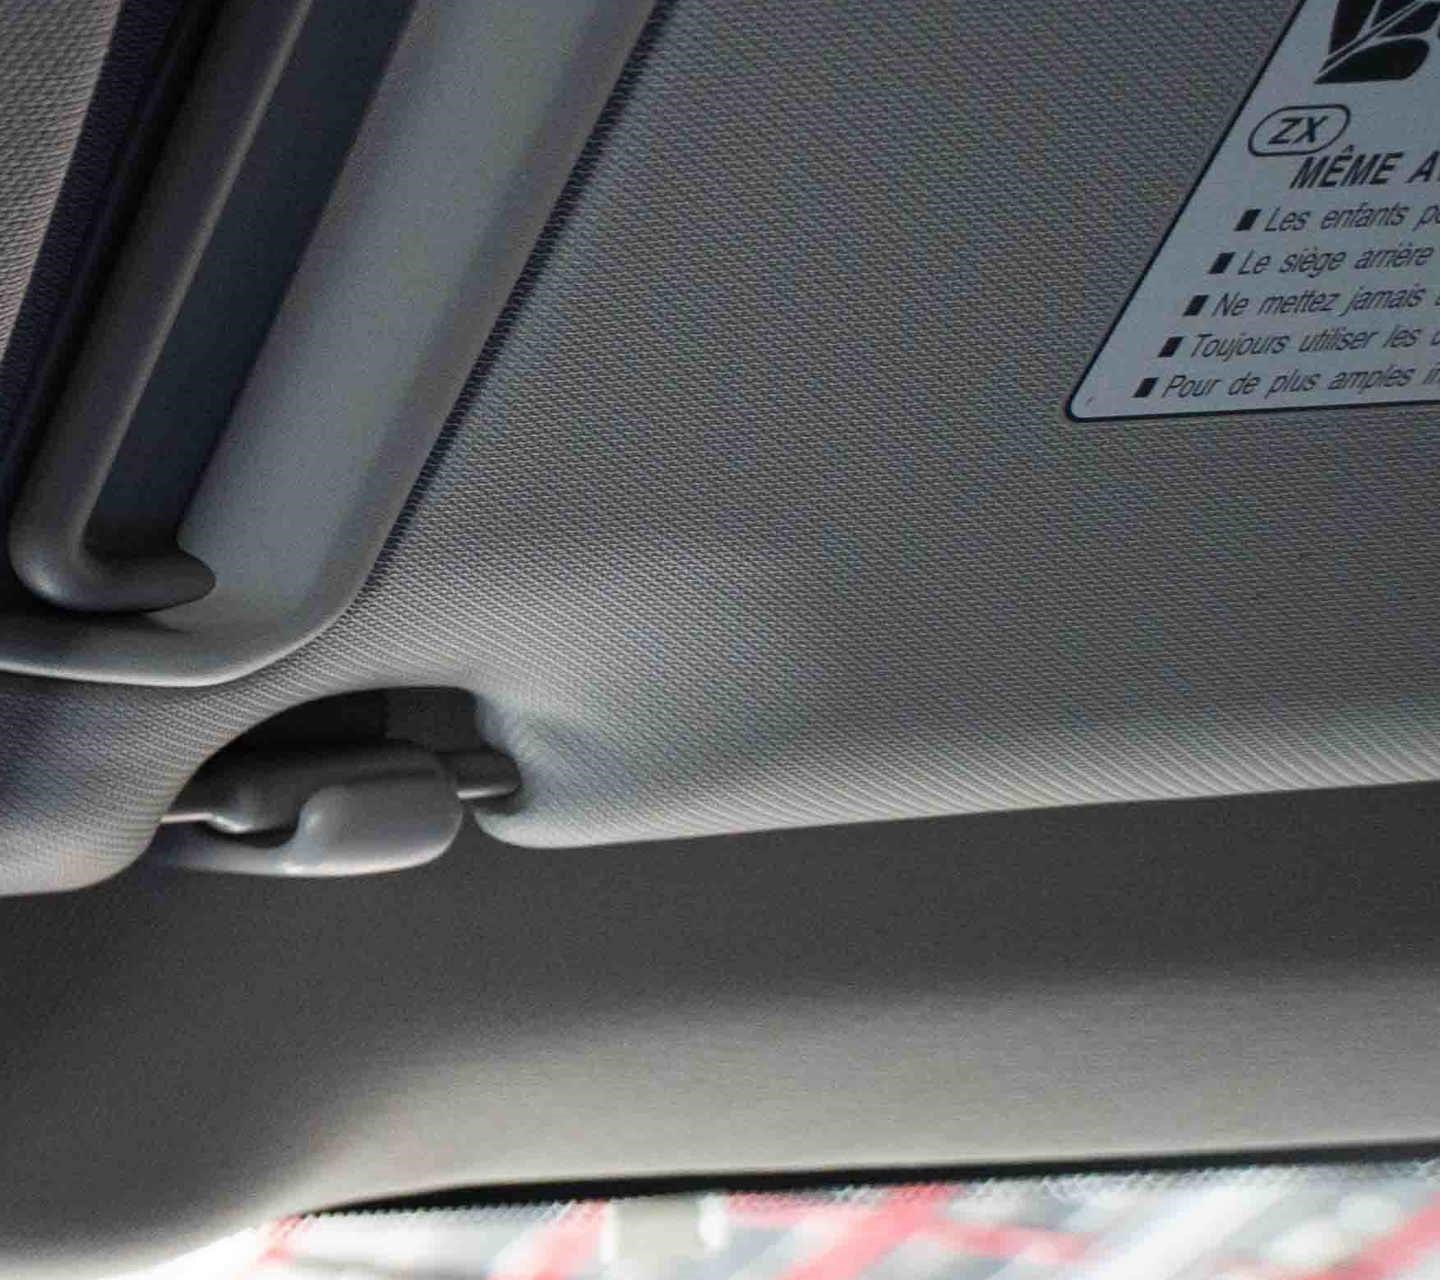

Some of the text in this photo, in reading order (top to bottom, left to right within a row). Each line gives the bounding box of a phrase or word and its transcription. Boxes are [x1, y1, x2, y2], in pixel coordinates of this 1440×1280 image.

[1268, 116, 1329, 145] ZX
[1289, 145, 1440, 189] MÊME A
[1264, 205, 1312, 233] Les
[1319, 201, 1411, 231] enfants
[1237, 241, 1435, 278] Le siège arrière
[1212, 291, 1250, 318] Ne
[1257, 288, 1342, 315] mettez
[1339, 282, 1428, 318] jamais
[1190, 332, 1291, 362] Toujours
[1298, 325, 1379, 354] utiliser
[1382, 324, 1423, 349] les
[1160, 374, 1223, 398] Pour
[1226, 371, 1261, 397] de
[1264, 370, 1323, 401] plus
[1327, 363, 1417, 395] amples
